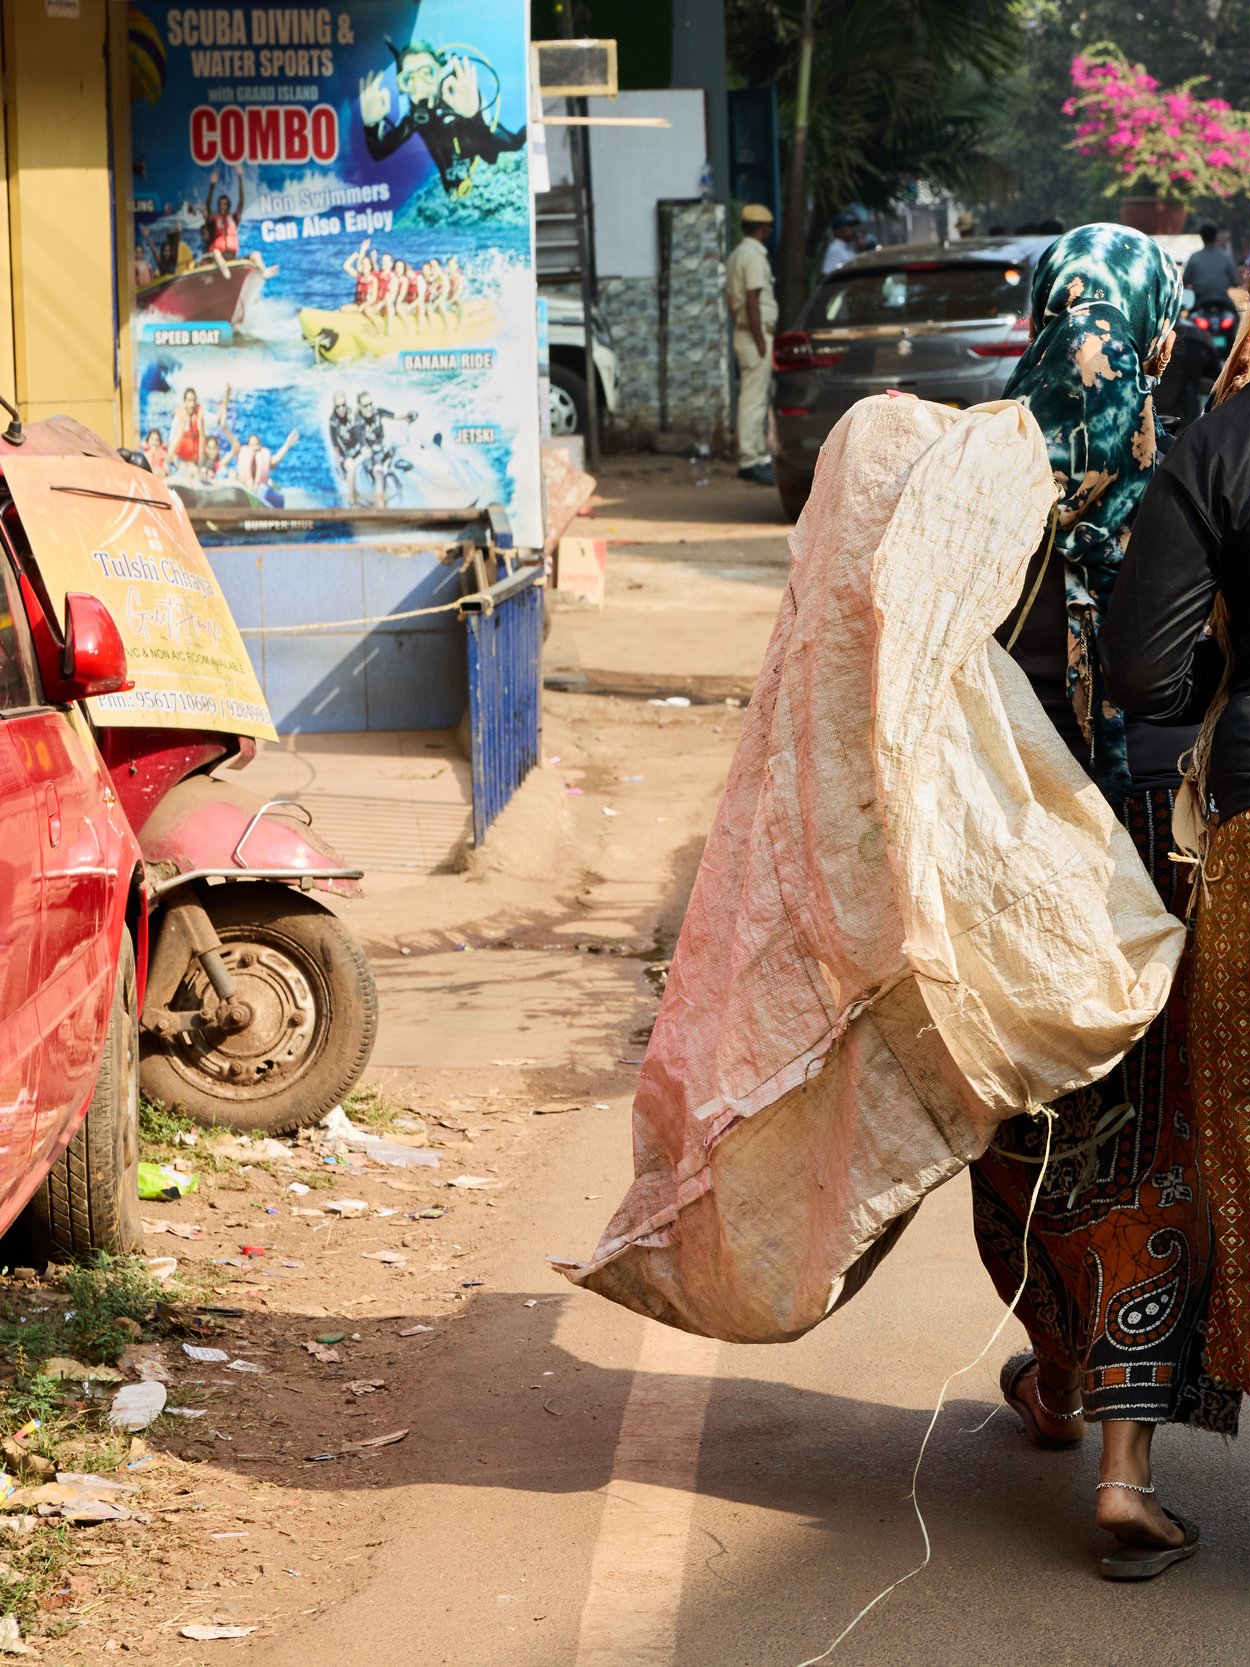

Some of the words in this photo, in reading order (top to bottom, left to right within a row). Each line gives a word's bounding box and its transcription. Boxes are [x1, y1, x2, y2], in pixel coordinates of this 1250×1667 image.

[167, 8, 248, 46] SCUBA
[252, 8, 332, 45] DIVING
[337, 13, 355, 45] &
[191, 50, 256, 78] WATER
[259, 50, 334, 77] SPORTS
[208, 86, 235, 102] with
[236, 85, 276, 101] GRAND
[278, 85, 318, 101] ISLAND
[190, 104, 339, 166] COMBO
[259, 194, 295, 214] Non
[300, 183, 390, 211] Swimmers
[261, 220, 299, 243] Can
[302, 215, 341, 238] Also
[344, 208, 393, 235] Enjoy
[154, 330, 190, 345] SPEED
[192, 330, 220, 345] BOAT
[404, 355, 457, 371] BANANA
[460, 353, 493, 370] RIDE
[455, 428, 495, 444] JETSKI
[94, 551, 160, 582] Tulshi
[161, 560, 214, 598] Chhaya
[142, 648, 149, 658] &
[150, 648, 170, 660] NON
[172, 650, 185, 662] A/C
[186, 652, 209, 665] ROOM
[209, 657, 245, 674] AVAILABLE
